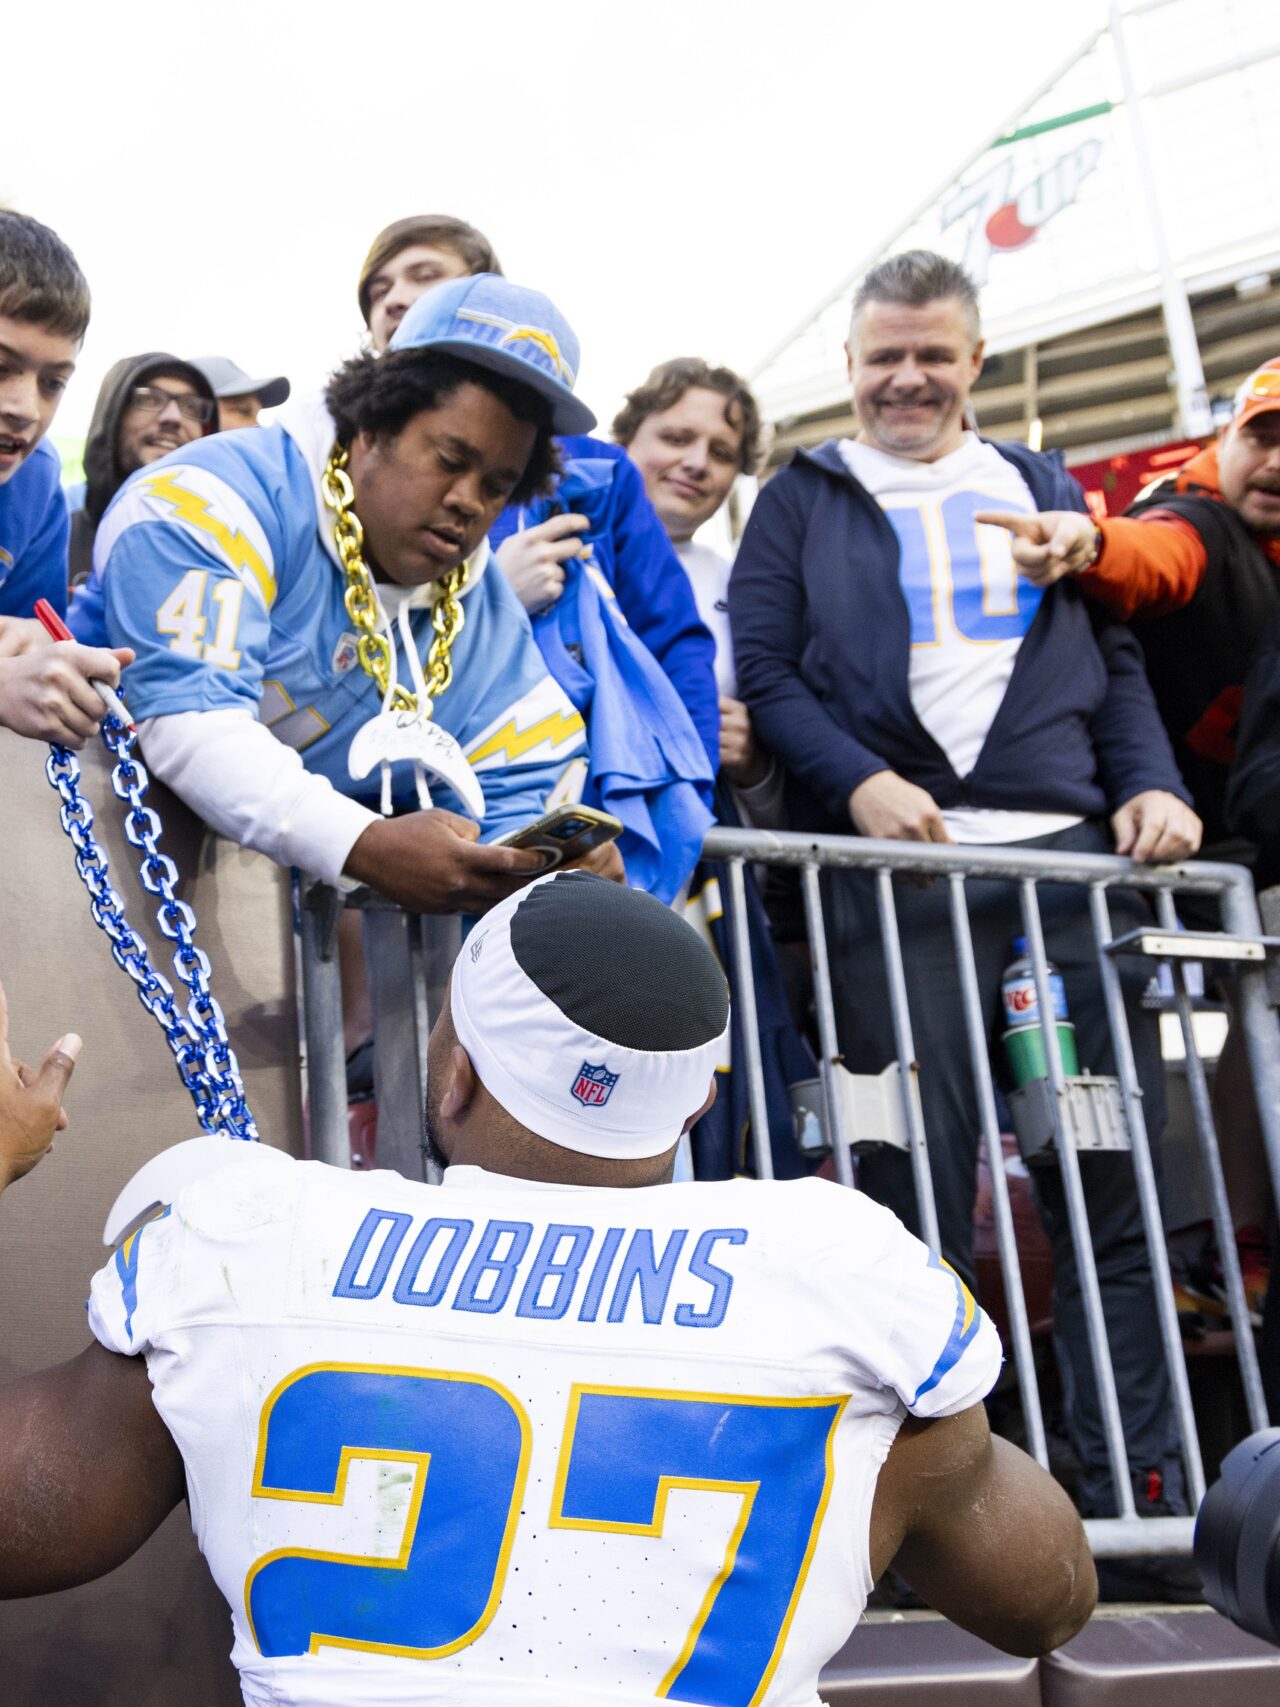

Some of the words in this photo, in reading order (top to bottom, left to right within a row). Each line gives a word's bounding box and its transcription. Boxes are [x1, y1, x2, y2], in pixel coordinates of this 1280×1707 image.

[156, 569, 245, 672] 41
[574, 1076, 605, 1104] NFL
[332, 1207, 749, 1329] DOBBINS
[244, 1360, 853, 1707] 27
